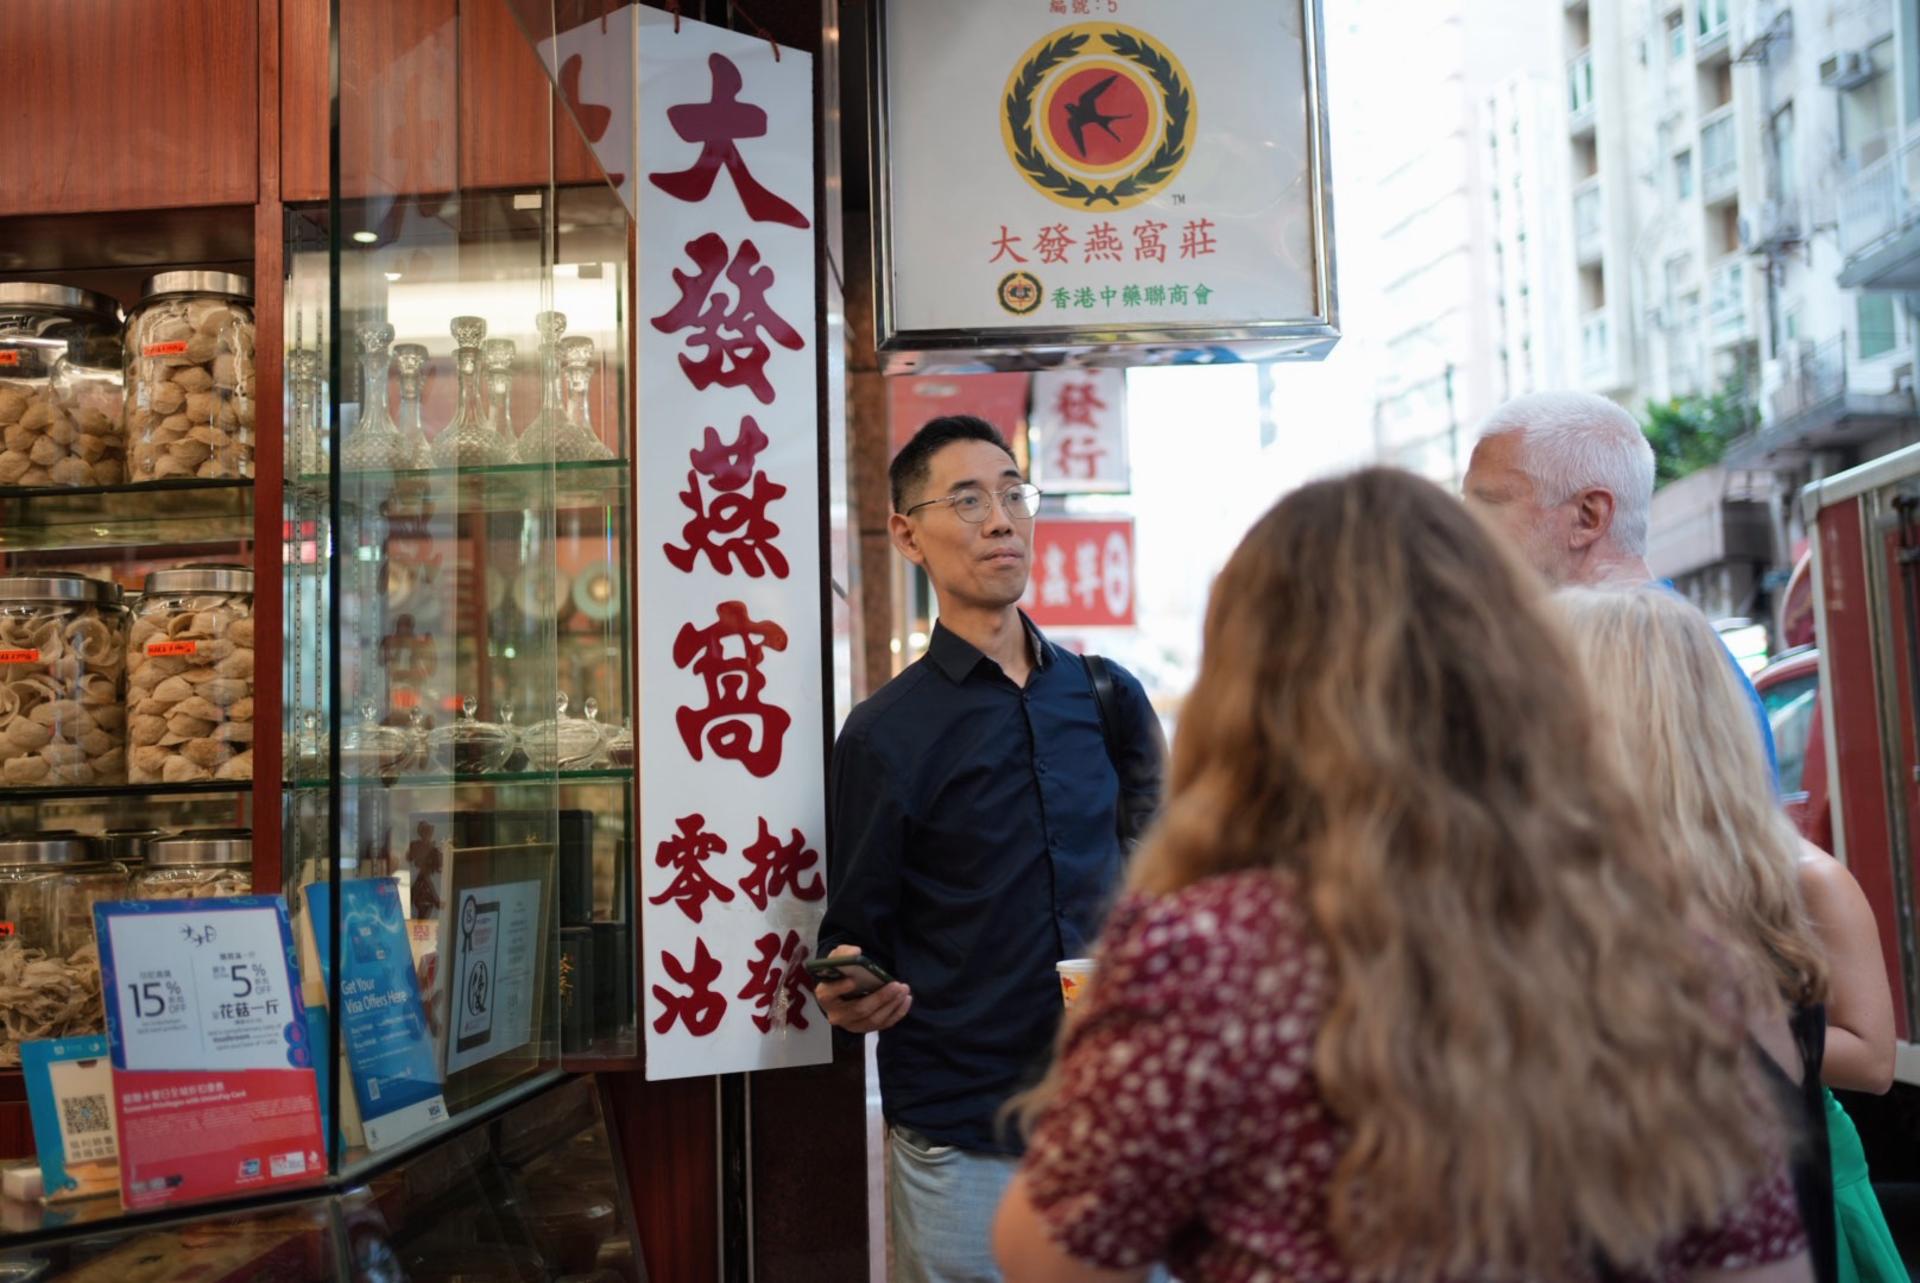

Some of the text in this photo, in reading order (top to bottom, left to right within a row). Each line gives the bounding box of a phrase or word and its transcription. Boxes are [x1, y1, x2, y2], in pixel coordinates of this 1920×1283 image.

[988, 218, 1217, 264] 大發燕窩莊
[1050, 282, 1215, 309] 香港中藥聯商會
[648, 52, 811, 778] 大發燕窩
[648, 813, 735, 1037] 零沽
[340, 977, 375, 995] Get Your
[344, 989, 408, 1016] Visa Offers Here
